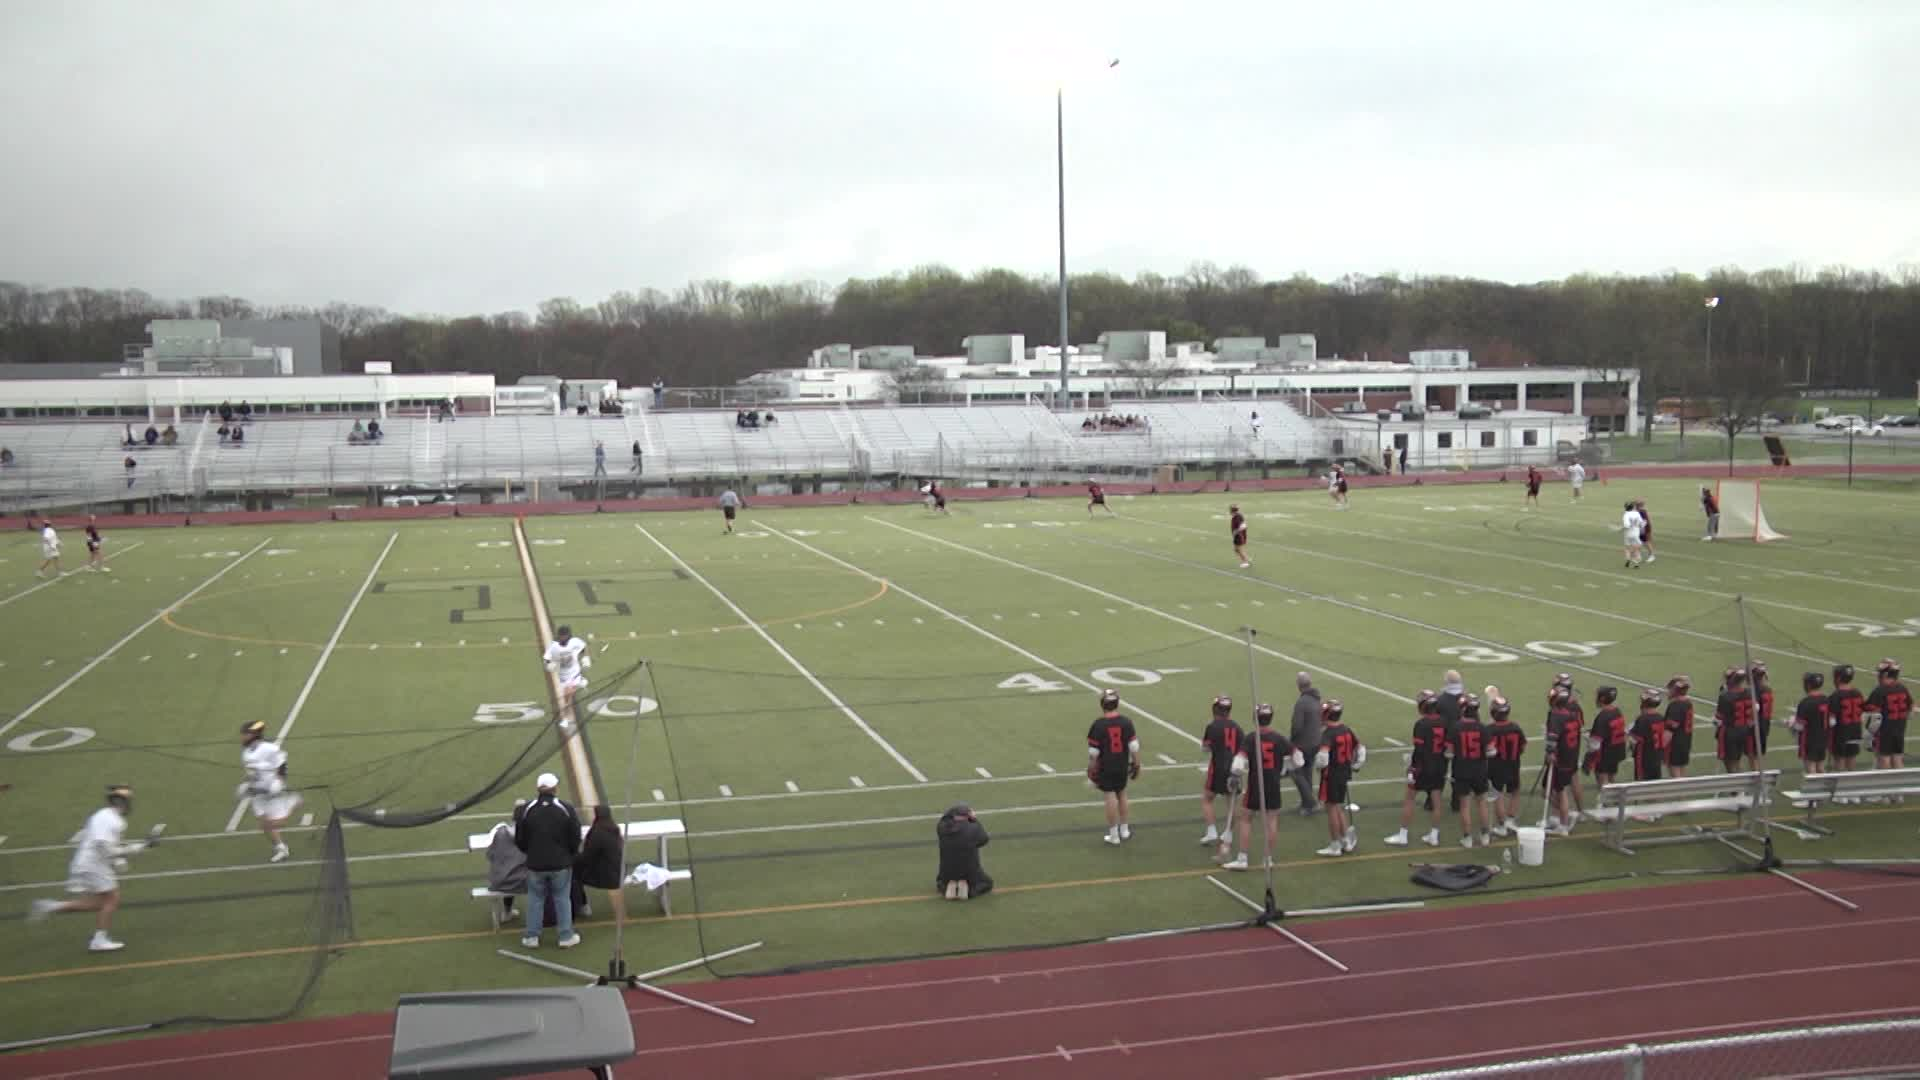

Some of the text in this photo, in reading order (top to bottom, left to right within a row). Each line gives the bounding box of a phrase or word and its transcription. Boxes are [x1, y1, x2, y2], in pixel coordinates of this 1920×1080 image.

[997, 666, 1163, 692] 40
[473, 695, 658, 722] 50
[1460, 731, 1481, 759] 15
